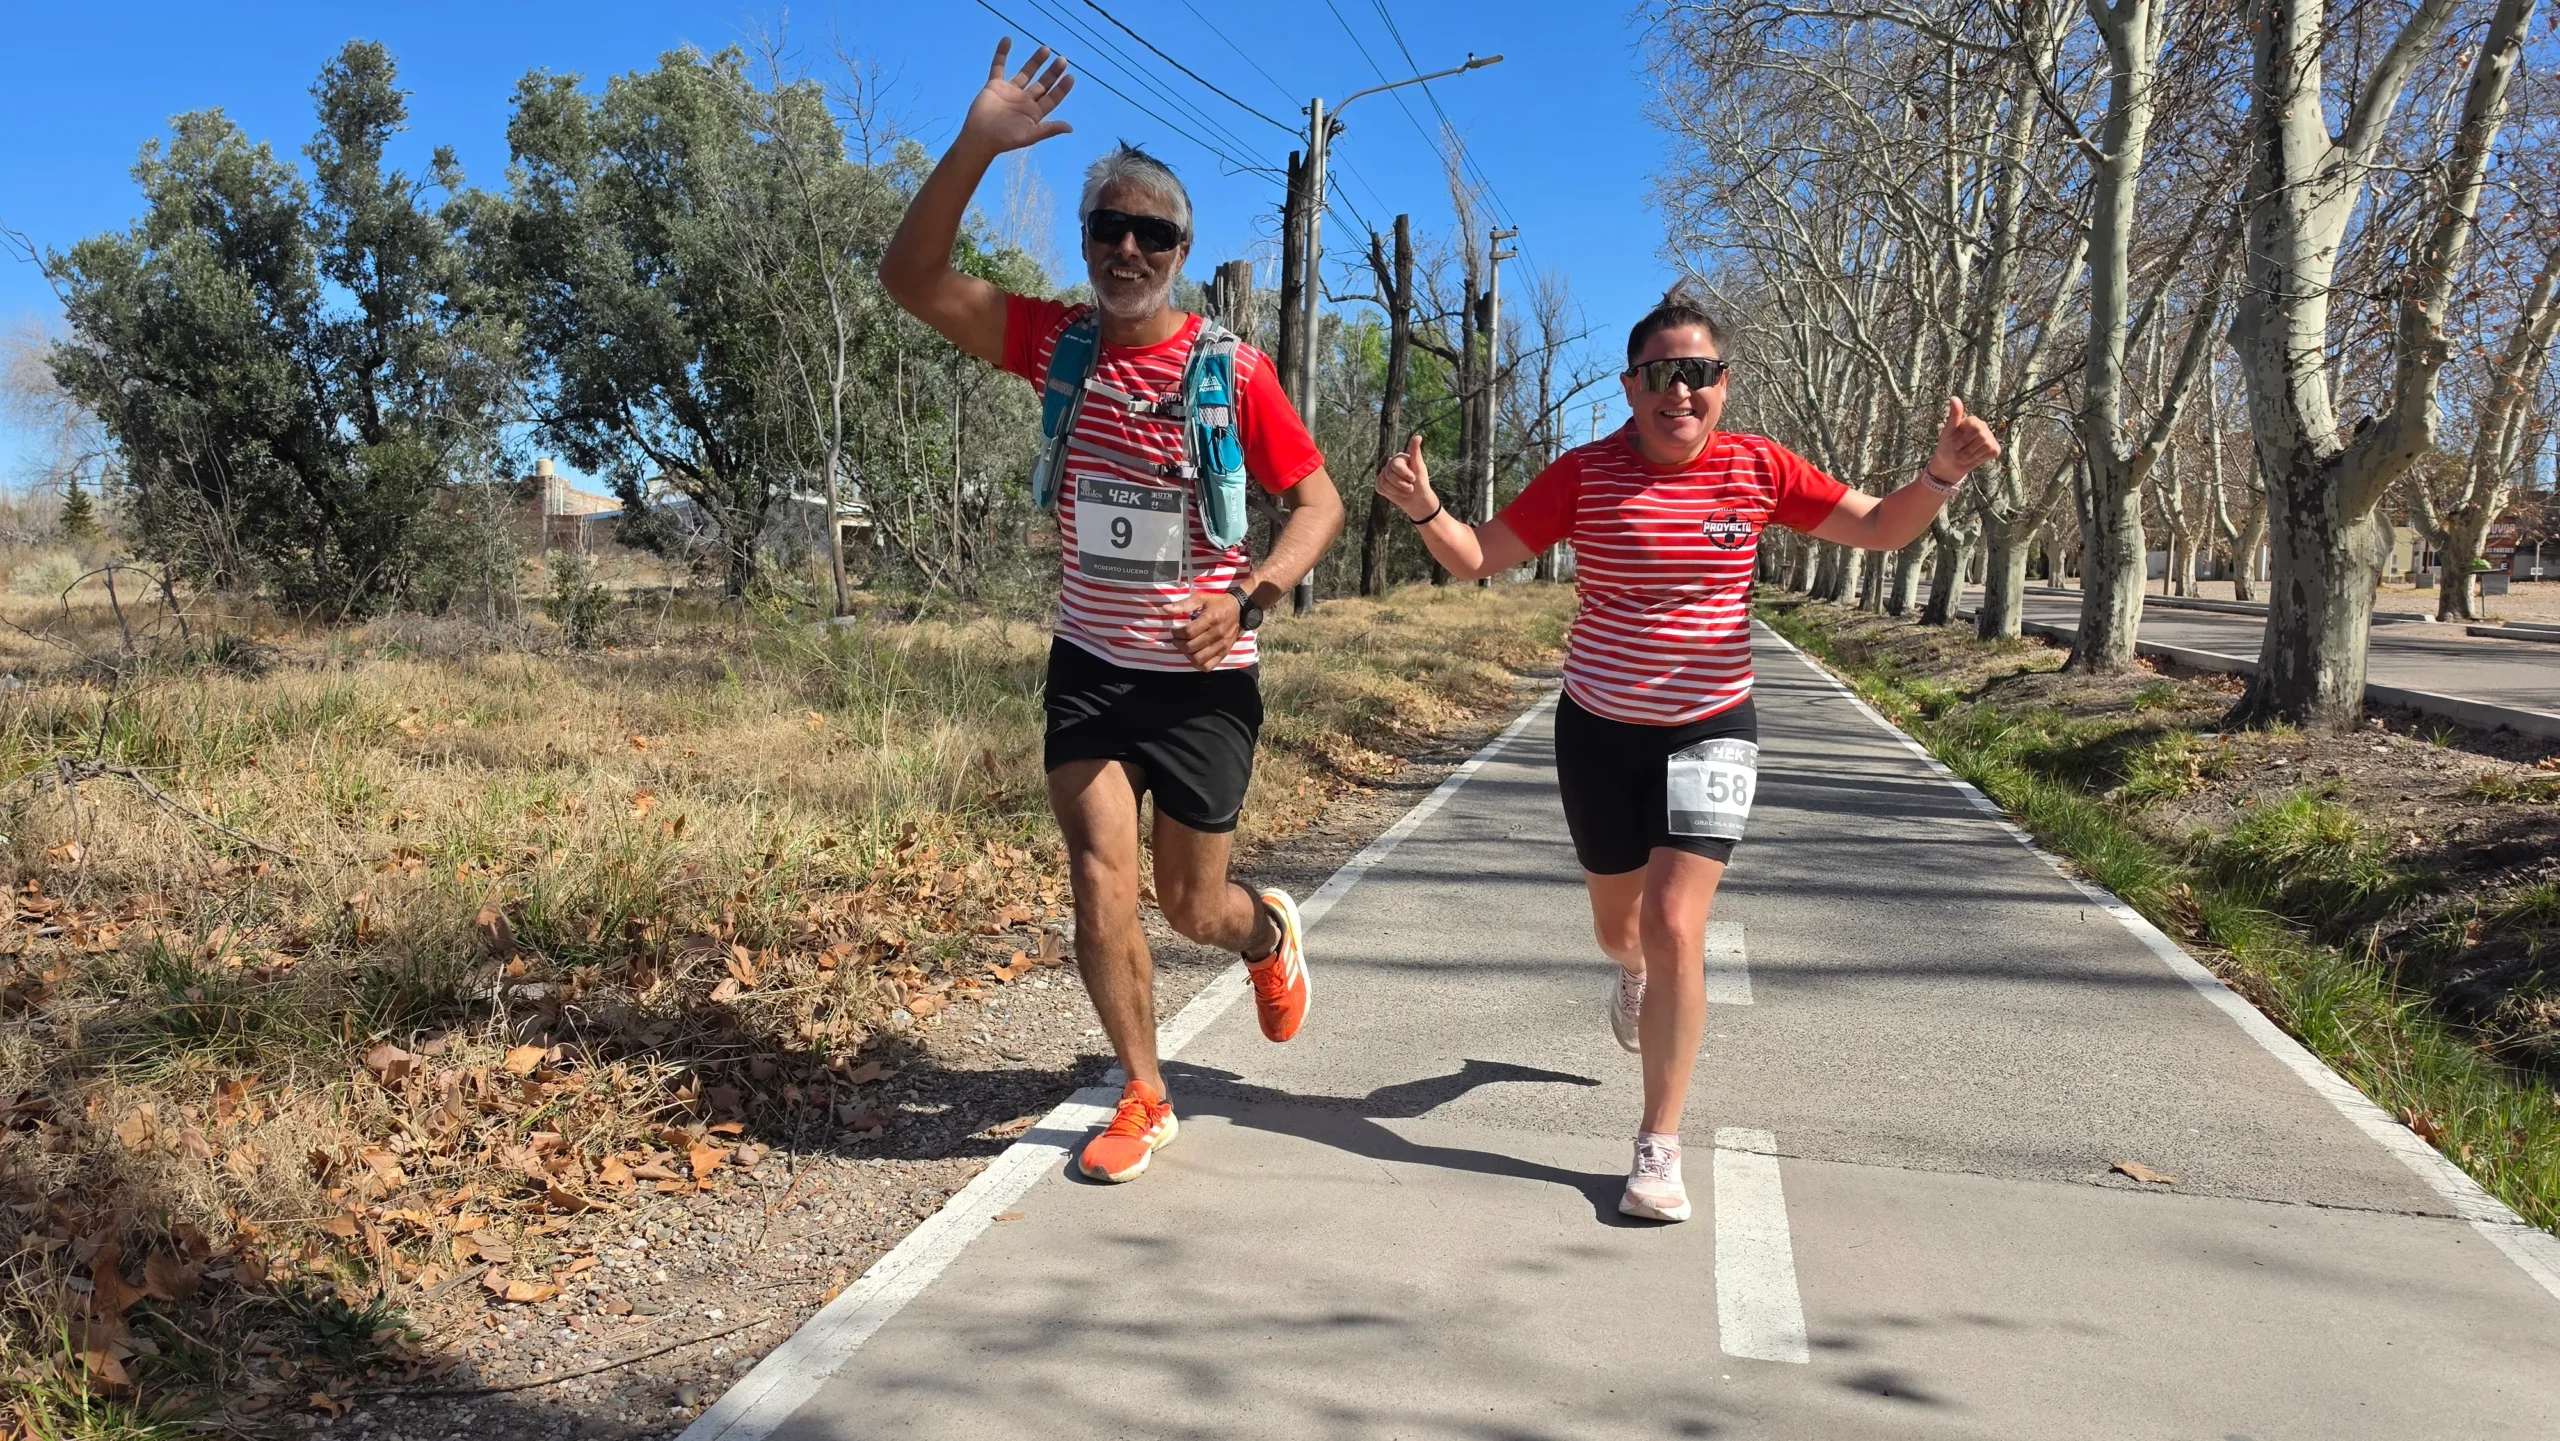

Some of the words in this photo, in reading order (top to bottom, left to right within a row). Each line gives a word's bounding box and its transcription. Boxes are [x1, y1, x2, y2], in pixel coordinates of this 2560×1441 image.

[1159, 392, 1182, 402] PROY
[1108, 489, 1144, 505] 42K
[1110, 516, 1133, 549] 9
[1703, 521, 1752, 533] PROYECTO
[1093, 564, 1122, 572] ROBERTO
[1122, 567, 1149, 575] LUCERO
[1712, 746, 1746, 762] 42K
[1706, 770, 1747, 807] 58
